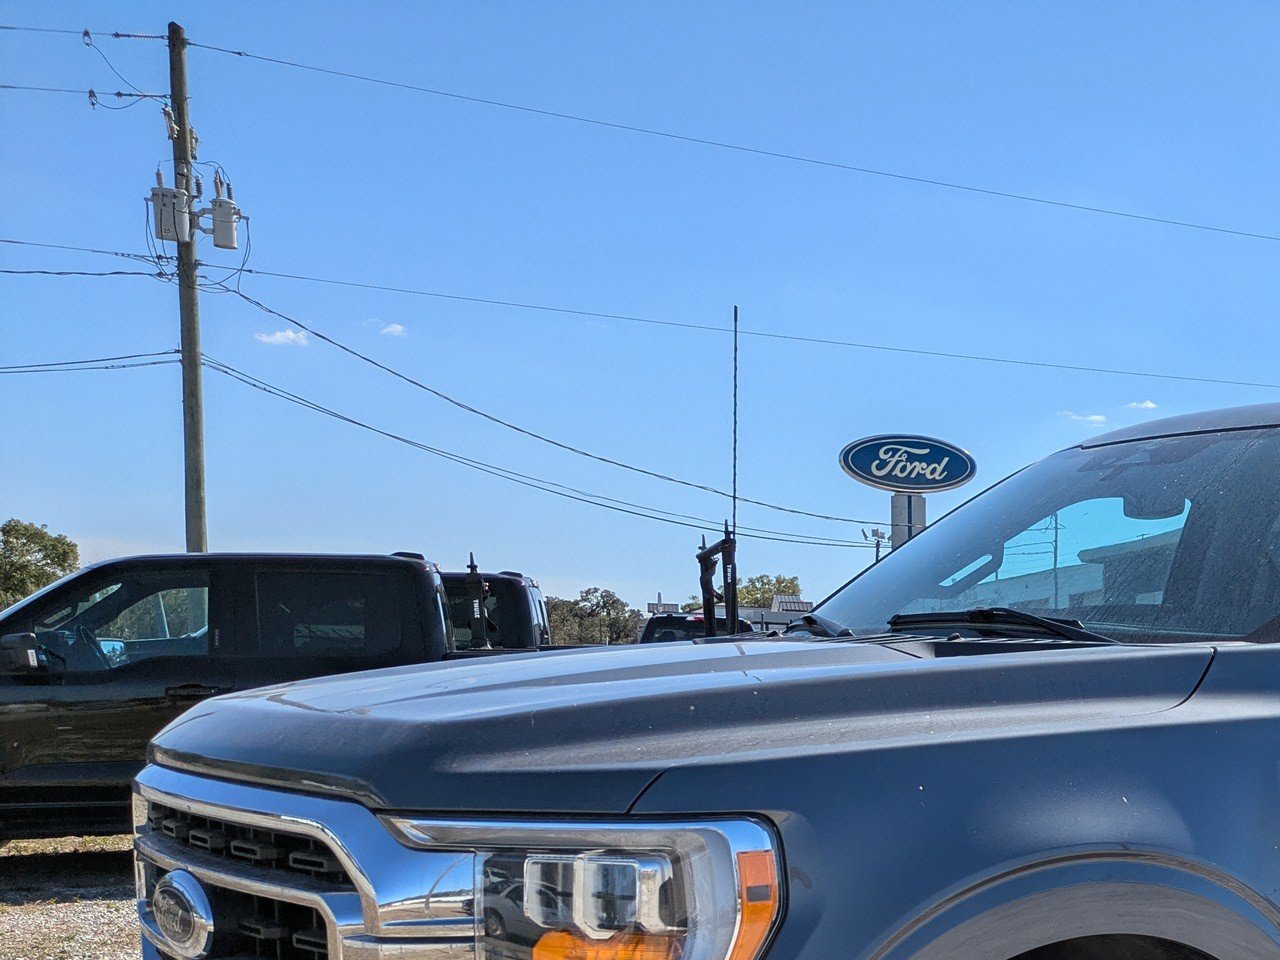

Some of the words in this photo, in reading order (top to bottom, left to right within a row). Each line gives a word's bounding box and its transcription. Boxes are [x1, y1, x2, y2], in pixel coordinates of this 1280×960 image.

[870, 444, 950, 481] Ford
[472, 598, 481, 619] THULE
[159, 896, 183, 934] Ford
